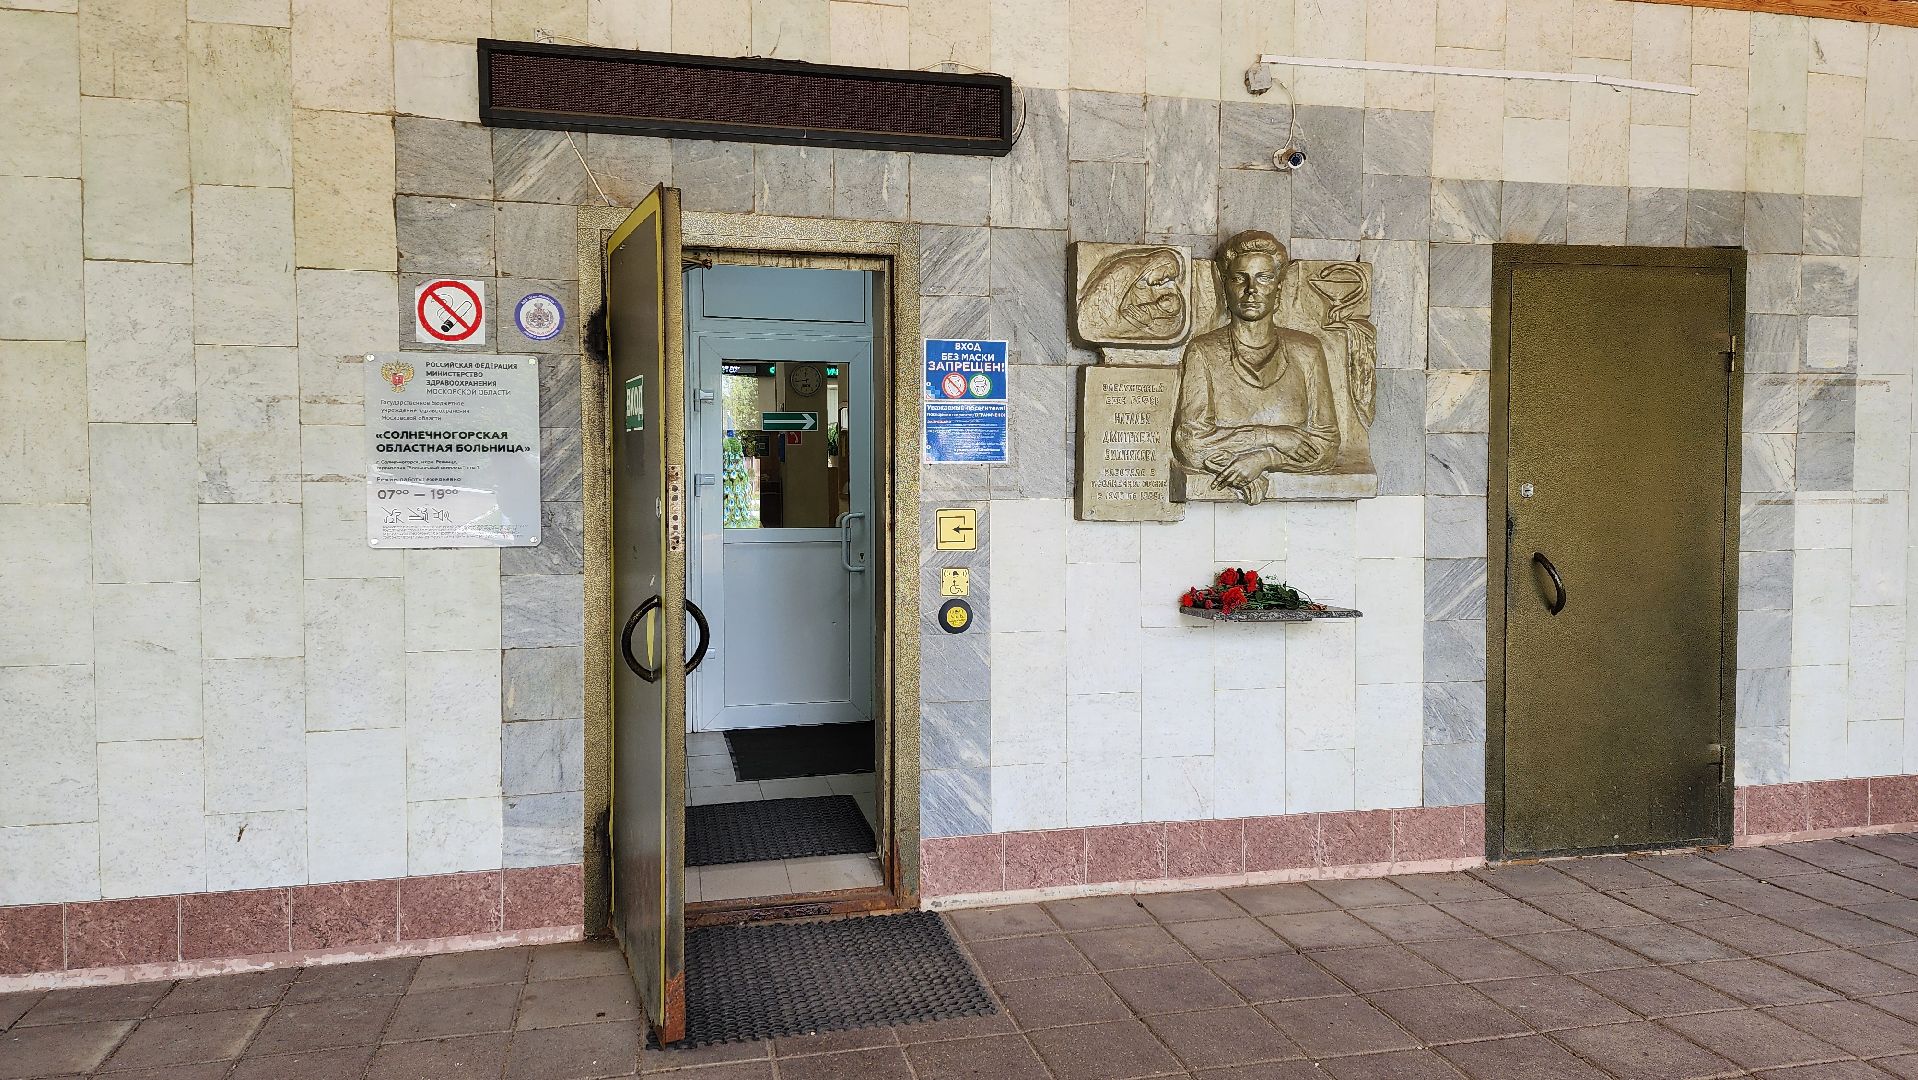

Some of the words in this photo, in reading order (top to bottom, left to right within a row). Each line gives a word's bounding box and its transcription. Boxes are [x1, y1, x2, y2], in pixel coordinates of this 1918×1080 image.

[954, 342, 982, 352] ВХОД
[941, 352, 960, 361] БЕЗ
[961, 353, 995, 362] МАСКИ
[425, 361, 473, 369] РОССИЙСКАЯ
[474, 362, 518, 371] ФЕДЕРАЦИЯ
[927, 360, 1006, 374] ЗАПРЕЩЕН!
[425, 370, 484, 378] МИНИСТЕРСТВО
[425, 379, 497, 387] ЗДРАВООХРАНЕНИЯ
[426, 388, 477, 396] МОСКОВСКОЙ
[375, 430, 508, 440] «СОЛНЕЧНОГОРСКАЯ
[375, 443, 453, 453] ОБЛАСТНАЯ
[455, 444, 531, 454] БОЛЬНИЦА»
